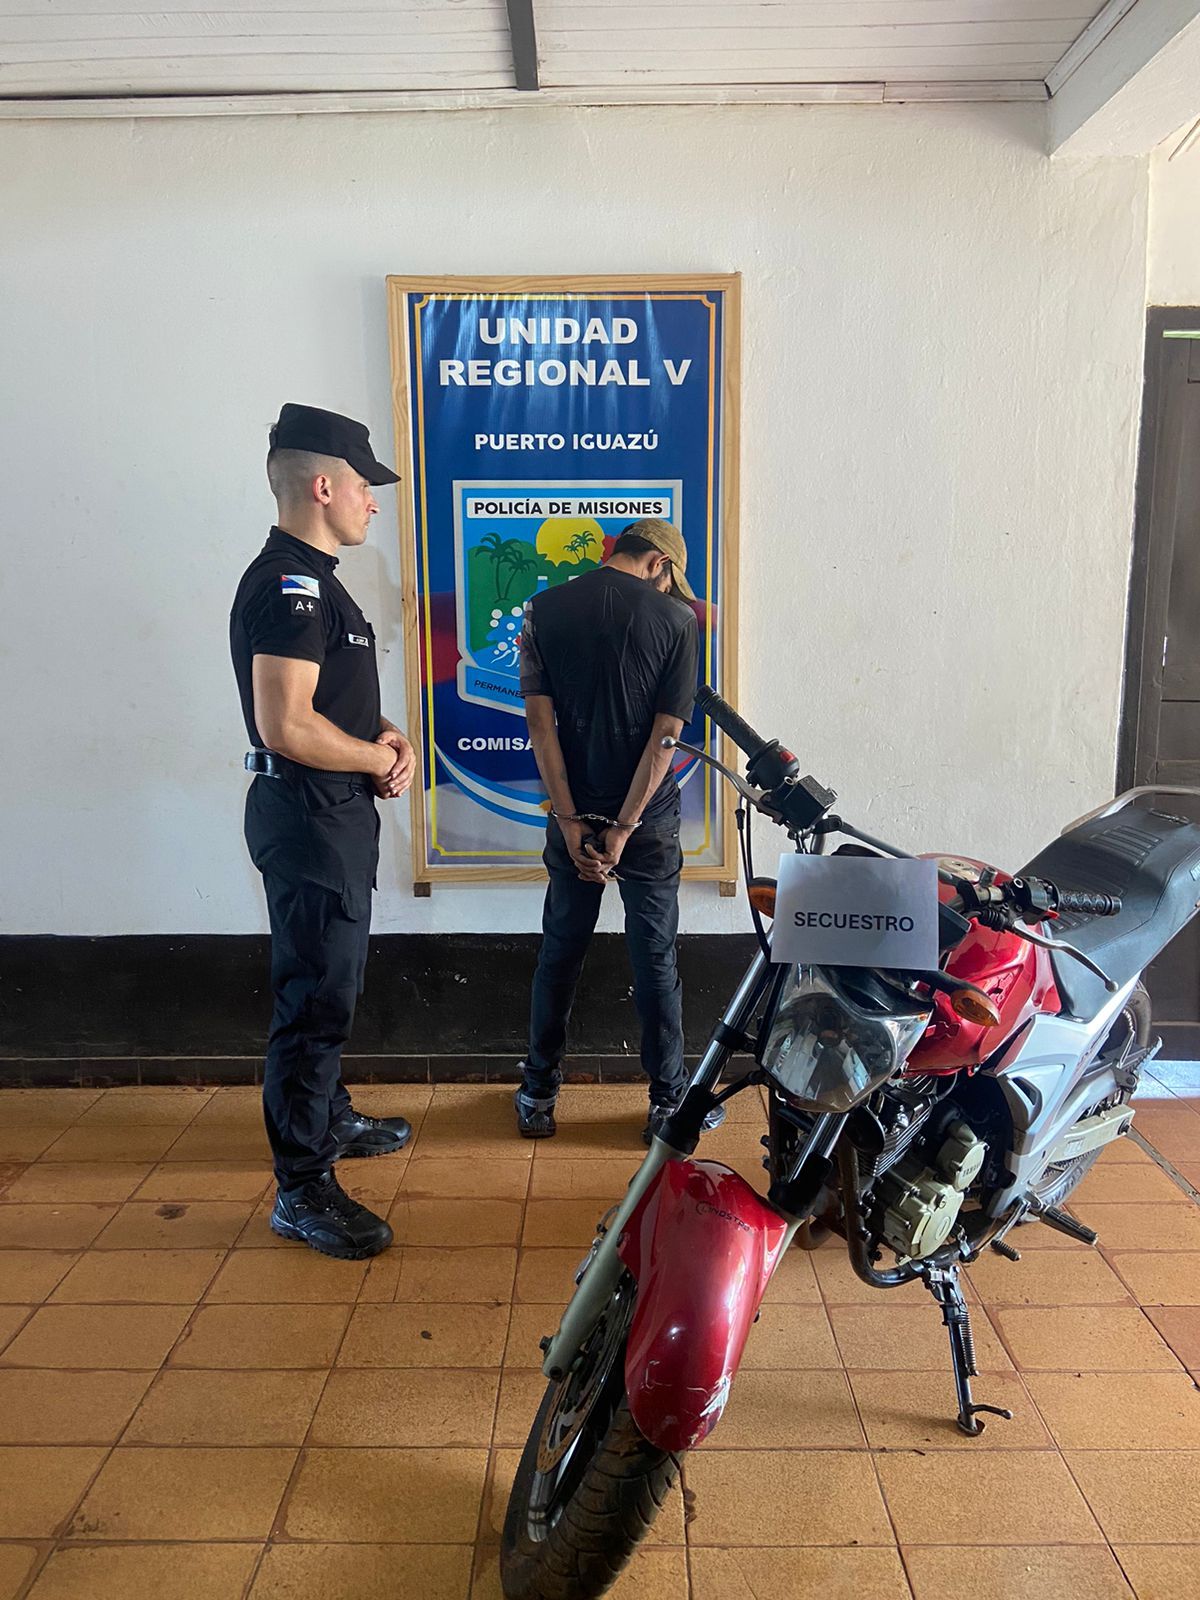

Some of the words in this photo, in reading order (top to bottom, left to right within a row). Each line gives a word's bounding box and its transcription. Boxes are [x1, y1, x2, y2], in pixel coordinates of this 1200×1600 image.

[479, 317, 638, 344] UNIDAD
[439, 359, 650, 386] REGIONAL
[663, 359, 692, 385] V
[474, 433, 565, 450] PUERTO
[573, 429, 659, 450] IGUAZÚ
[473, 498, 543, 515] POLICÍA
[549, 501, 572, 515] DE
[577, 501, 663, 515] MISIONES
[295, 600, 314, 612] A+
[793, 911, 914, 932] SECUESTRO
